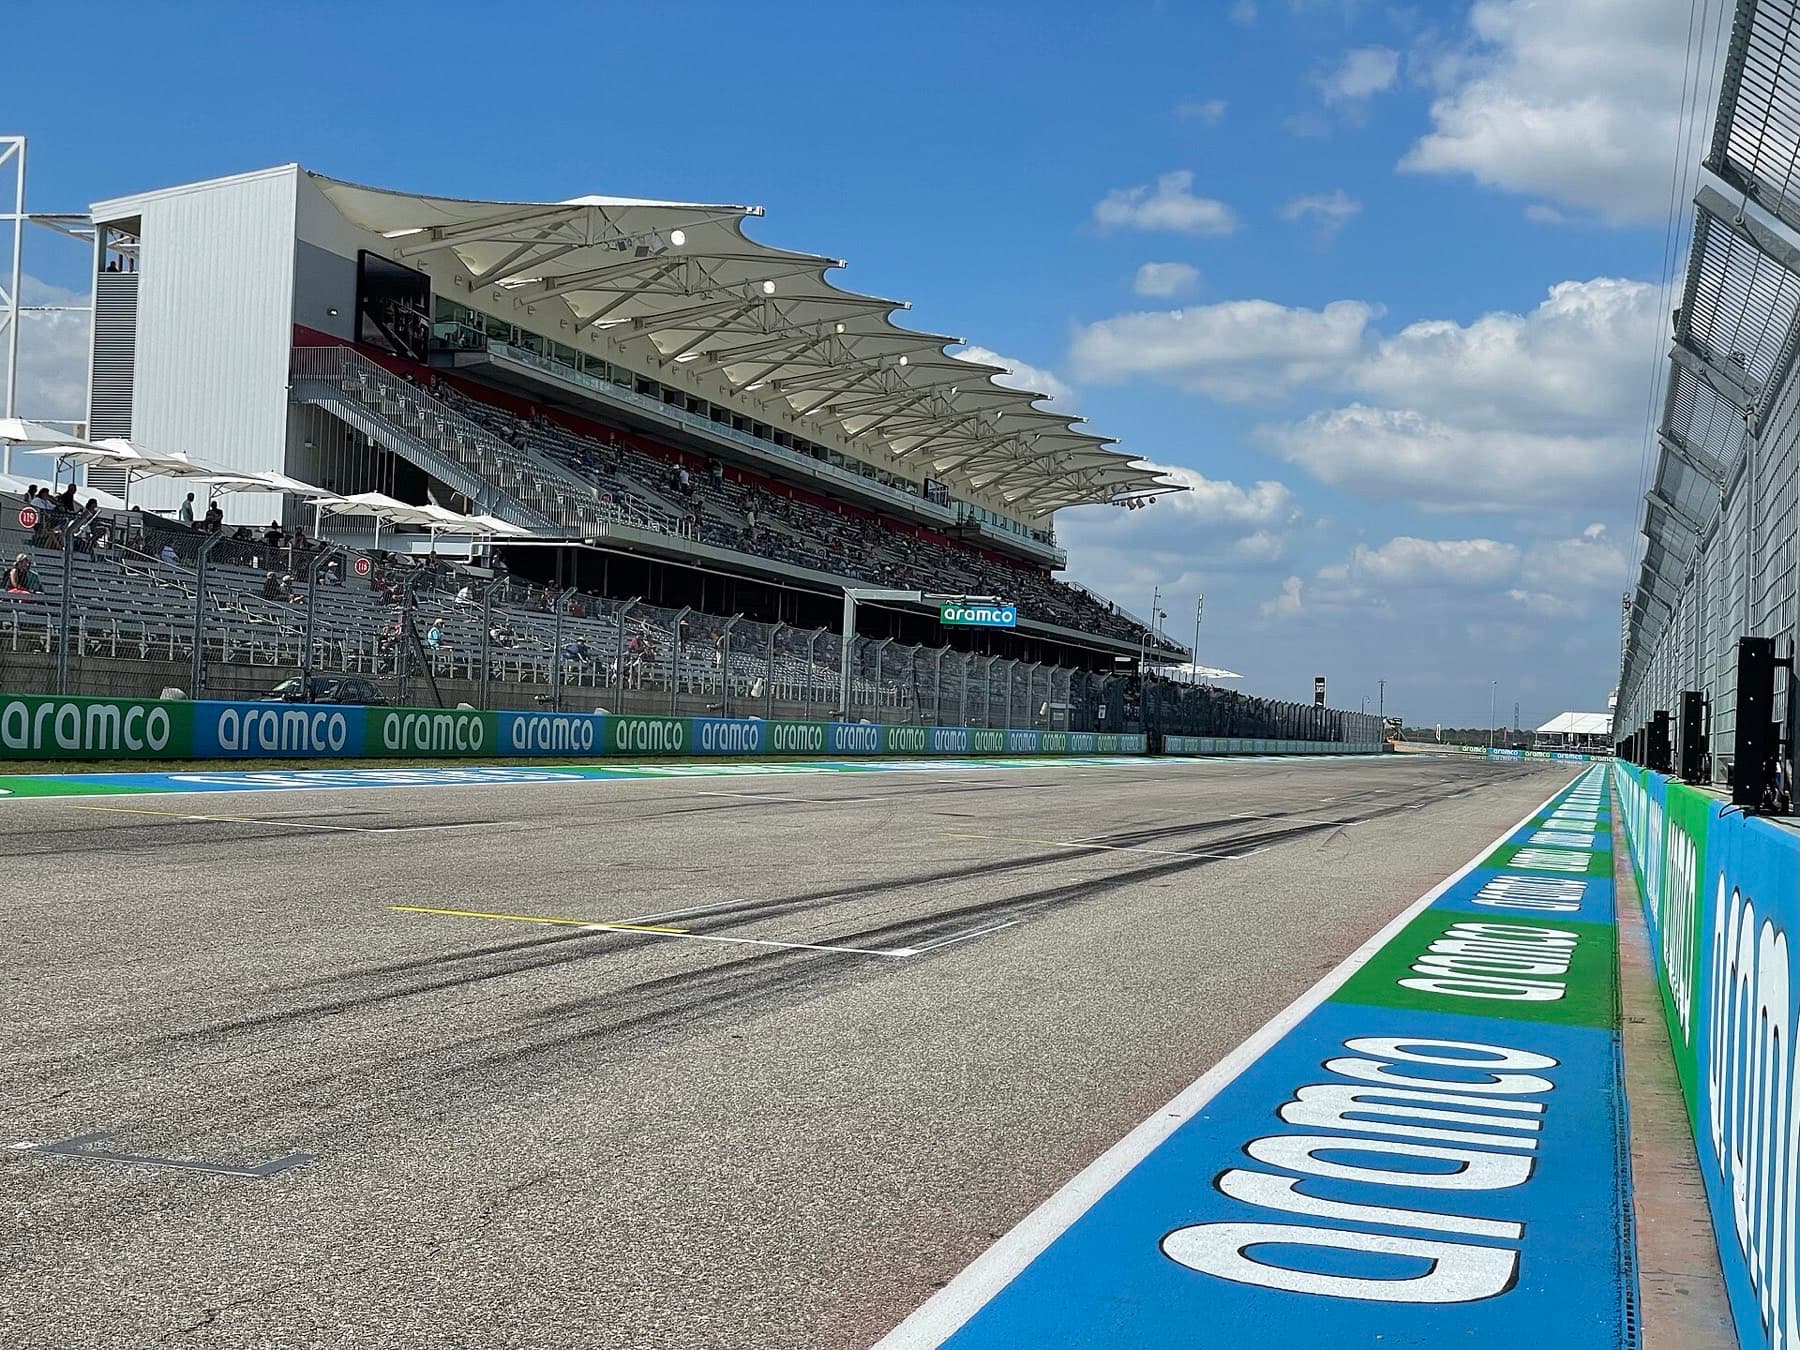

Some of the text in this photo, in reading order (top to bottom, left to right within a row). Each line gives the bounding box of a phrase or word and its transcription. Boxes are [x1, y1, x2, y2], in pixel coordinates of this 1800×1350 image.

[944, 608, 1013, 623] aramco
[1, 701, 171, 751] aramco
[218, 708, 347, 752] aramco
[382, 713, 484, 751] aramco
[512, 716, 593, 750] aramco
[616, 719, 683, 750] aramco
[702, 722, 758, 750] aramco
[774, 724, 822, 750] aramco
[836, 726, 877, 750] aramco
[888, 727, 925, 750] aramco
[934, 730, 966, 750] aramco
[975, 731, 1003, 751] aramco
[1011, 733, 1036, 751] aramco
[1043, 734, 1066, 751] aramco
[1462, 745, 1487, 753] aramco
[1493, 748, 1518, 756] aramco
[1397, 922, 1580, 1001] aramco
[1708, 870, 1800, 1350] aram
[1158, 1036, 1561, 1304] aramco
